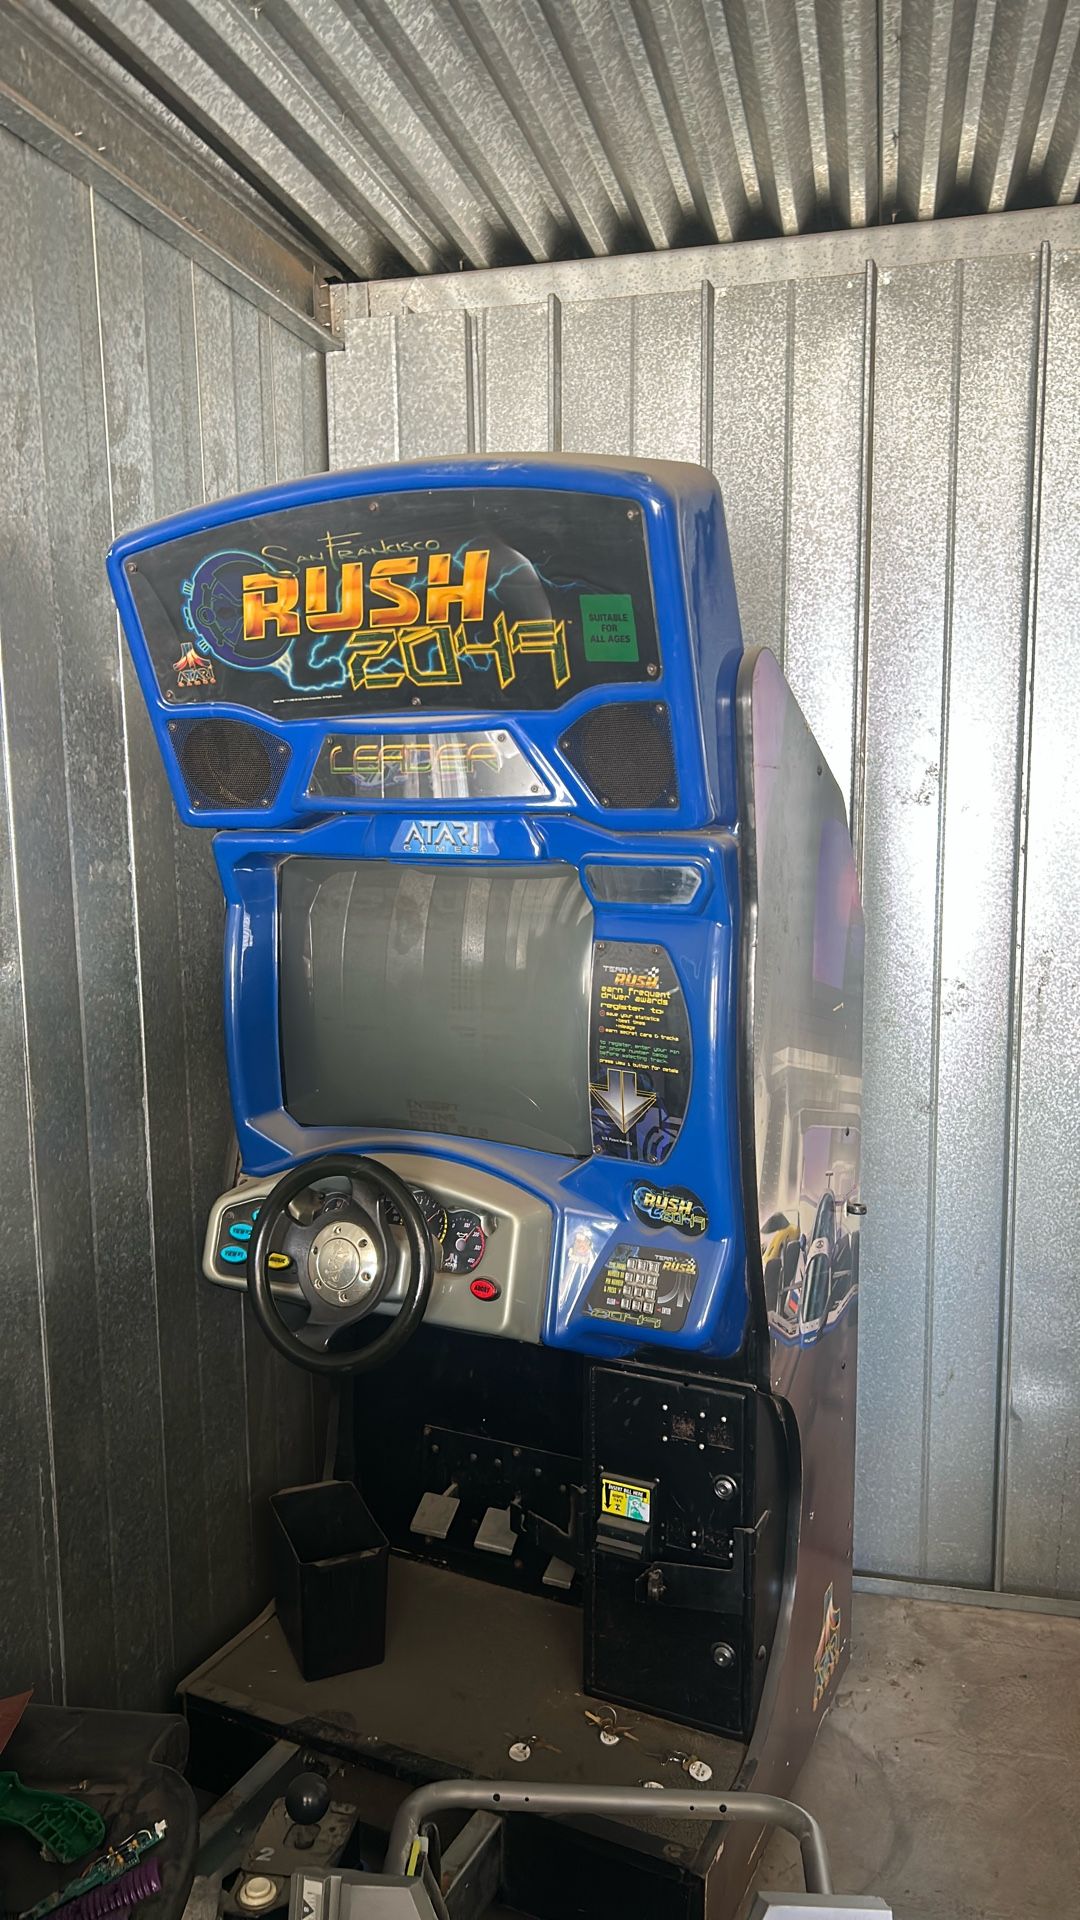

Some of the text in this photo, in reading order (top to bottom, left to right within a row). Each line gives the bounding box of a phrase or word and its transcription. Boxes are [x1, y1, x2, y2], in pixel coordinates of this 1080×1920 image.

[242, 550, 490, 641] RUSH
[588, 613, 629, 622] SUITABLE
[601, 624, 618, 633] FOR
[591, 635, 632, 644] ALL AGES
[348, 610, 571, 691] 2049
[176, 667, 216, 687] ATARI
[329, 743, 503, 774] LEADER
[403, 821, 480, 847] ATARI
[403, 845, 480, 854] GAMES
[614, 973, 660, 990] RUSH
[600, 991, 669, 1005] driver awards
[628, 987, 671, 999] frequent
[600, 1002, 645, 1013] register
[644, 1192, 694, 1215] RUSH
[662, 1261, 696, 1275] RUSH
[256, 1847, 275, 1861] 2
